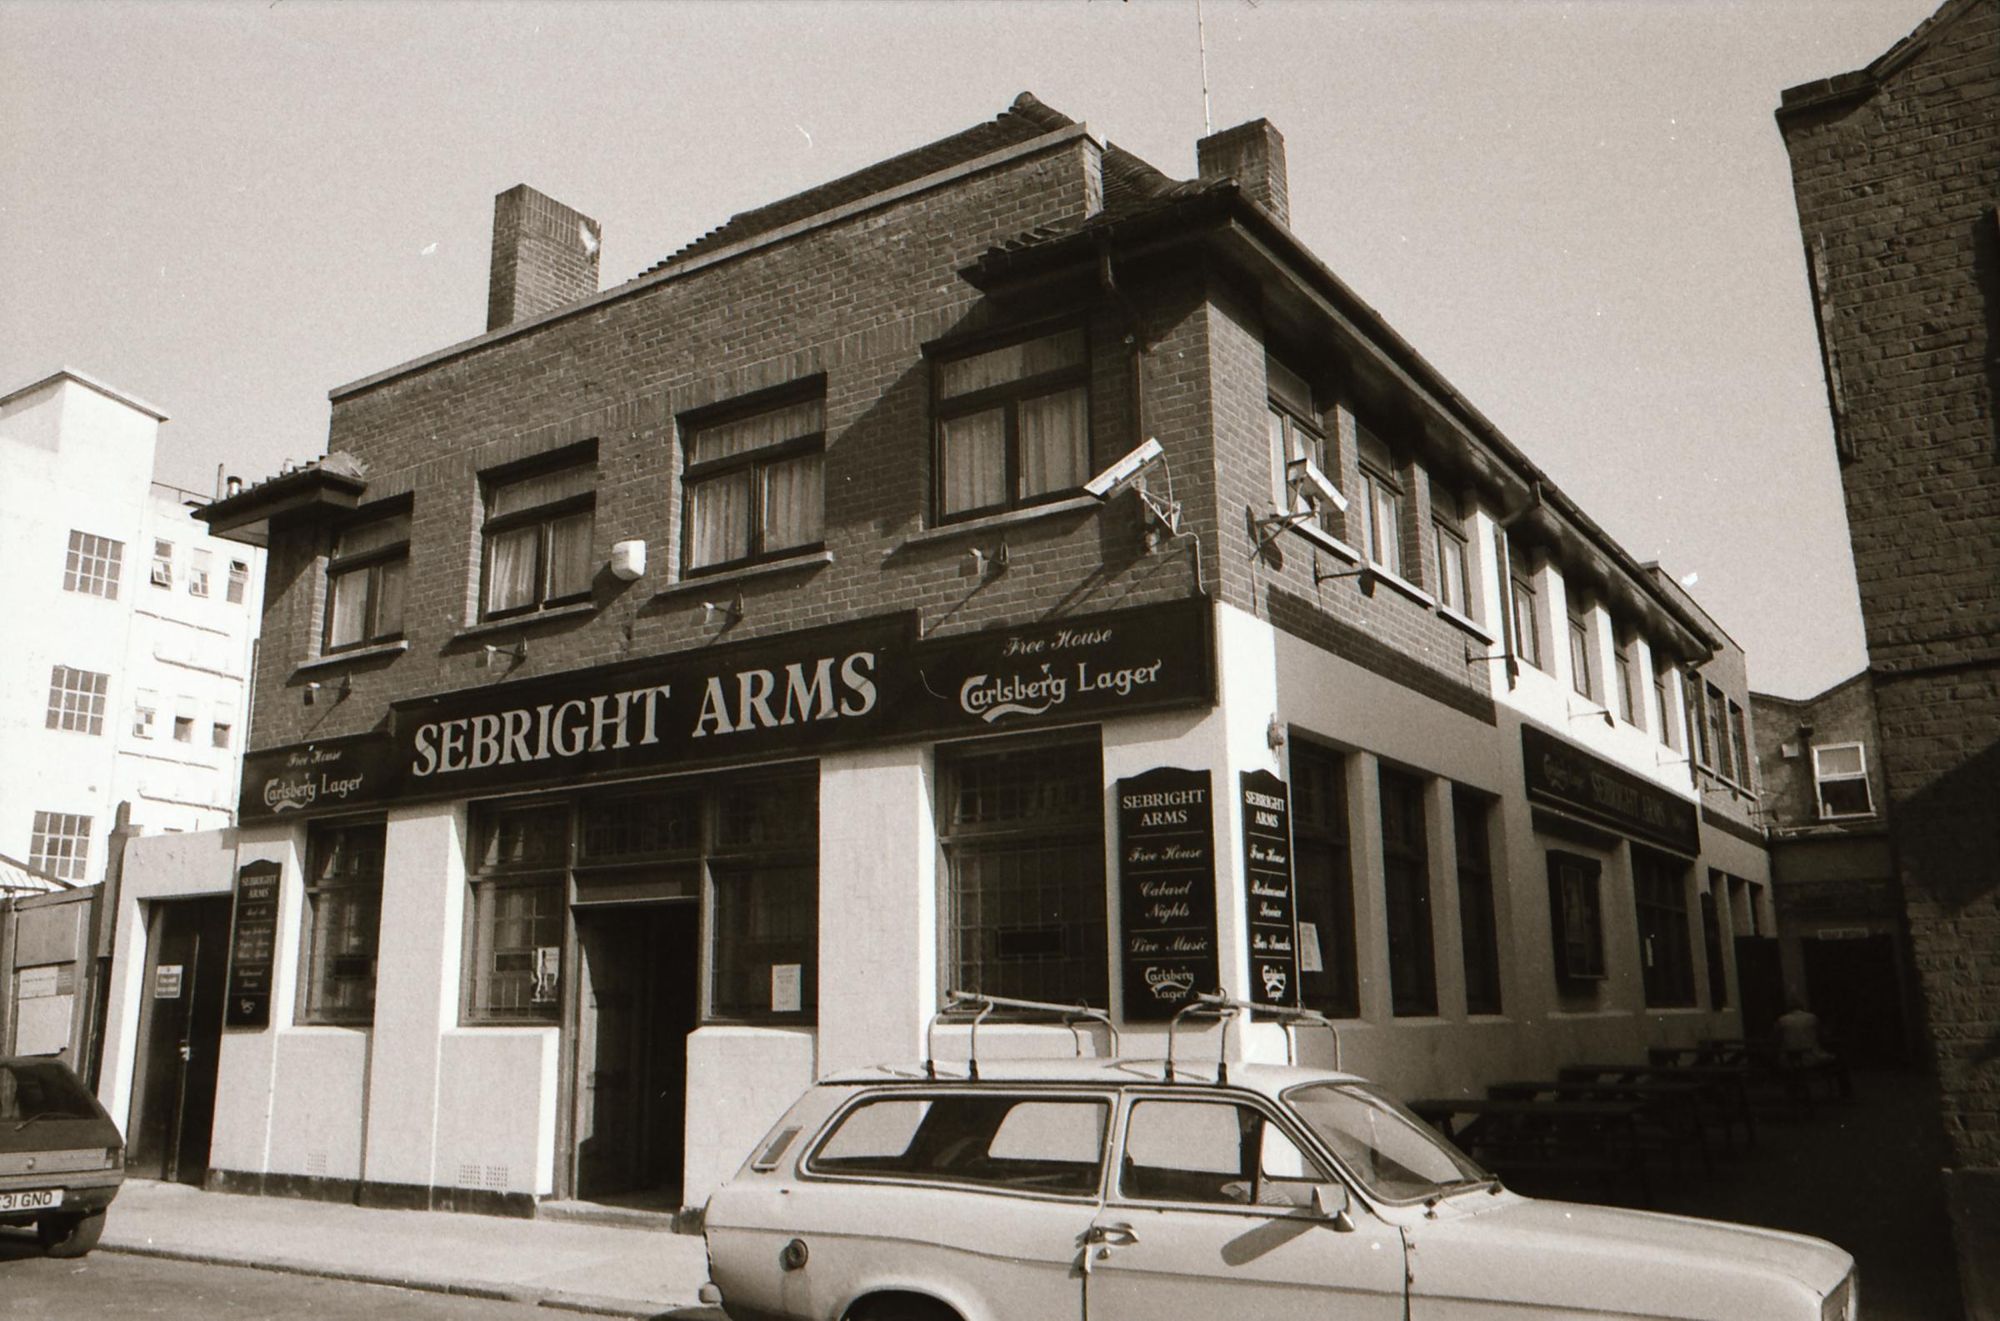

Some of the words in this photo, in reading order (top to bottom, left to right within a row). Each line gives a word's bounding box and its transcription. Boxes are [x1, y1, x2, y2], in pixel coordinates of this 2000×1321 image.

[1003, 637, 1045, 657] Free
[1051, 627, 1113, 650] House
[960, 664, 1067, 723] Carlsberg
[1077, 659, 1162, 696] Lager
[412, 684, 671, 778] SEBRIGHT
[692, 651, 877, 739] ARMS
[264, 773, 317, 813] Carlsberg
[321, 772, 364, 799] Lager
[1123, 789, 1206, 809] SEBRIGHT
[1141, 809, 1188, 827] ARMS
[1255, 810, 1279, 828] ARMS
[1128, 847, 1158, 862] Free
[1161, 844, 1203, 861] House
[1145, 902, 1190, 924] Nights
[1165, 936, 1208, 952] Music
[1145, 965, 1194, 991] Carlsberg
[1153, 988, 1188, 1003] Lager
[20, 1191, 53, 1208] GNO
